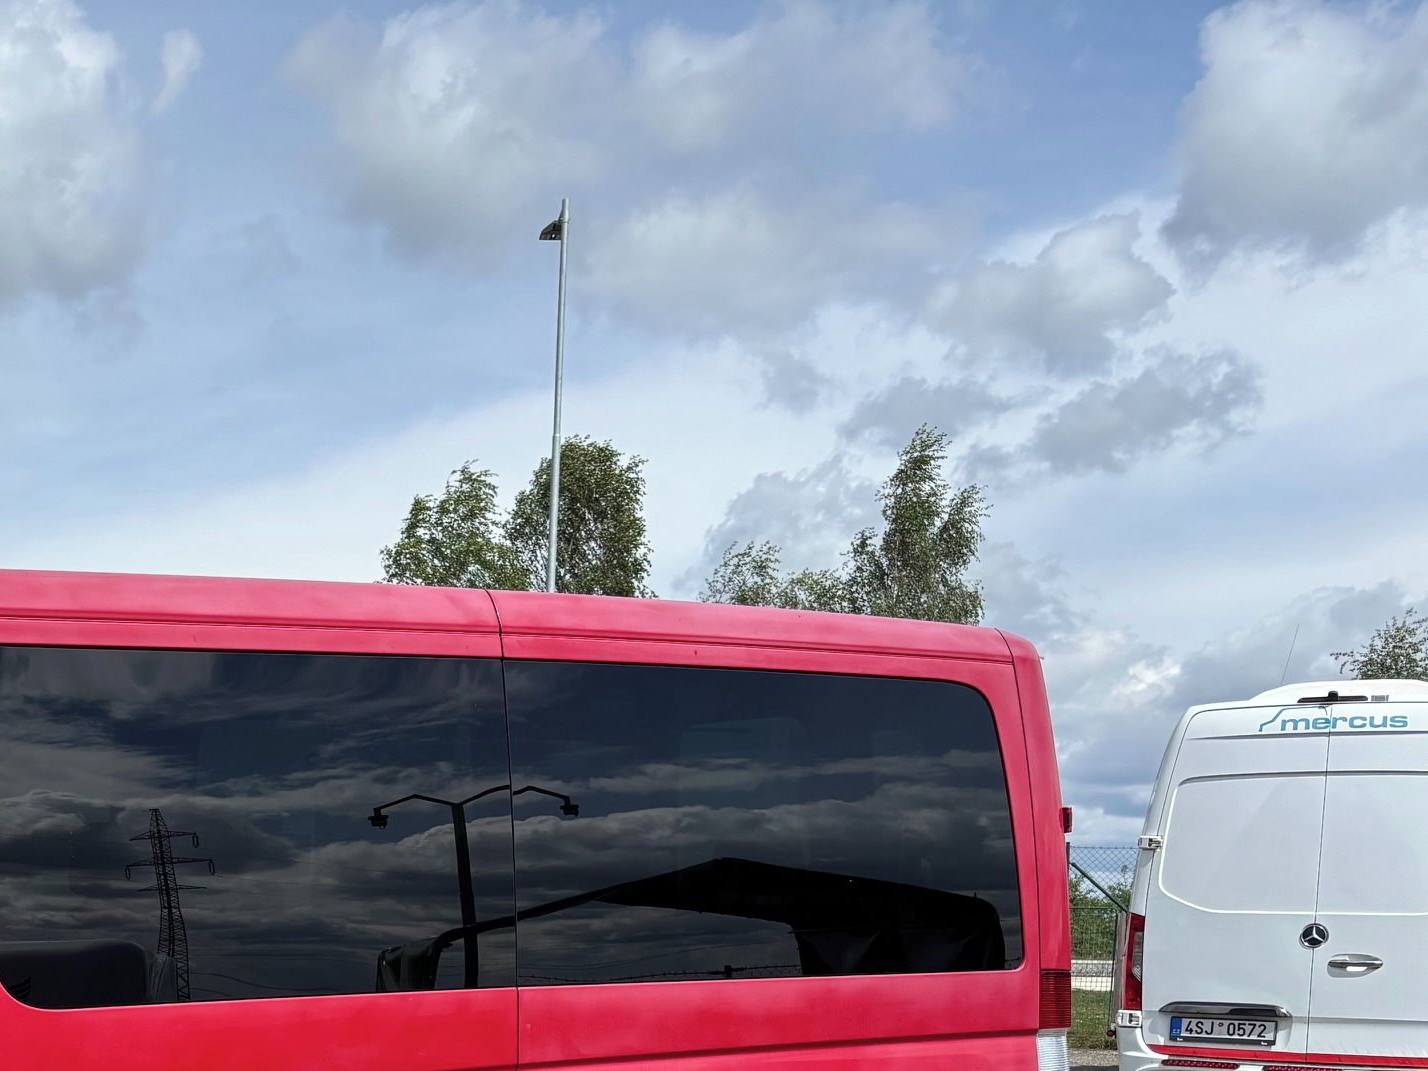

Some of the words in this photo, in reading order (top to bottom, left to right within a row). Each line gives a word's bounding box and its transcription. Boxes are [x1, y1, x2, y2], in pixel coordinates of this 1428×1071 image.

[1280, 715, 1409, 732] mercus
[1185, 1020, 1215, 1035] 4SJ
[1226, 1022, 1268, 1038] 0572
